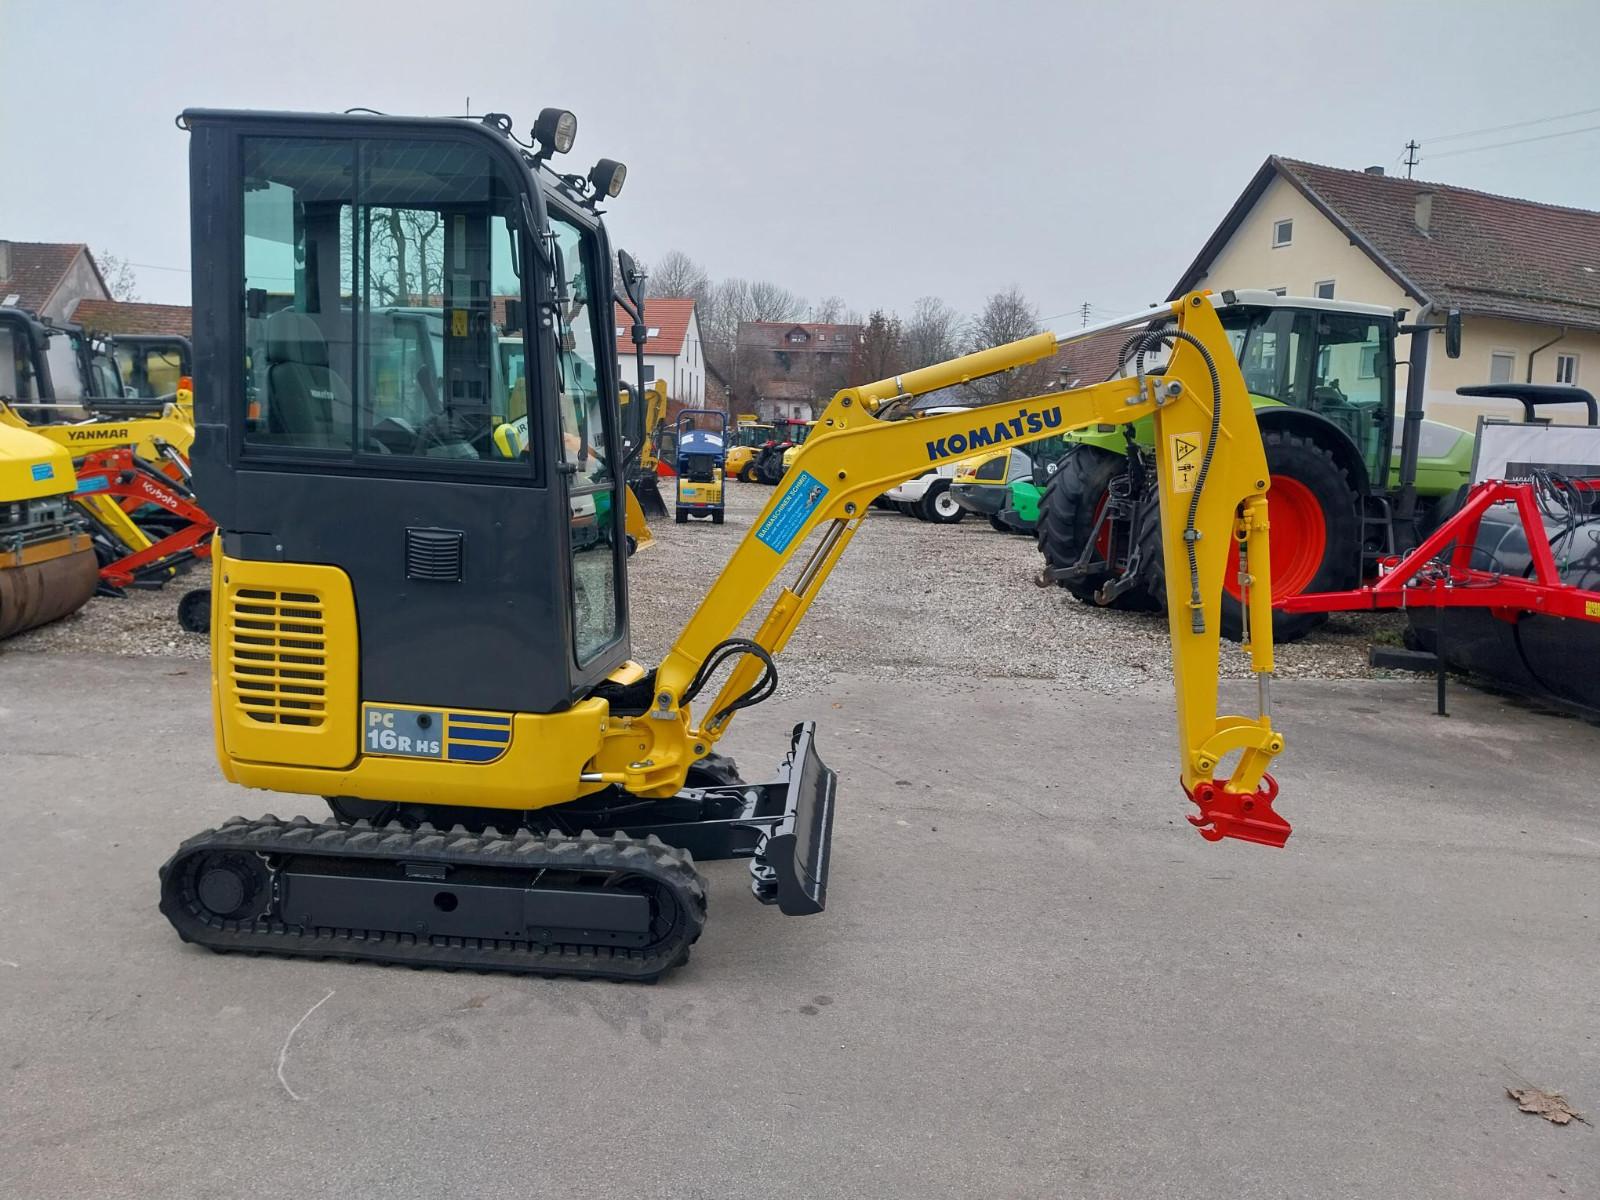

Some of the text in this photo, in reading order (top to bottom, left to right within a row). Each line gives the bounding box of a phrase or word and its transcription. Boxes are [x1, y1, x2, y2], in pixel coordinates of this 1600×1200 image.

[68, 429, 128, 440] YANMAR
[926, 406, 1062, 461] KOMATSU
[142, 481, 178, 508] Kubota
[758, 495, 792, 538] BAUMASCHINEN
[790, 474, 808, 497] SCHMID
[369, 711, 394, 728] PC
